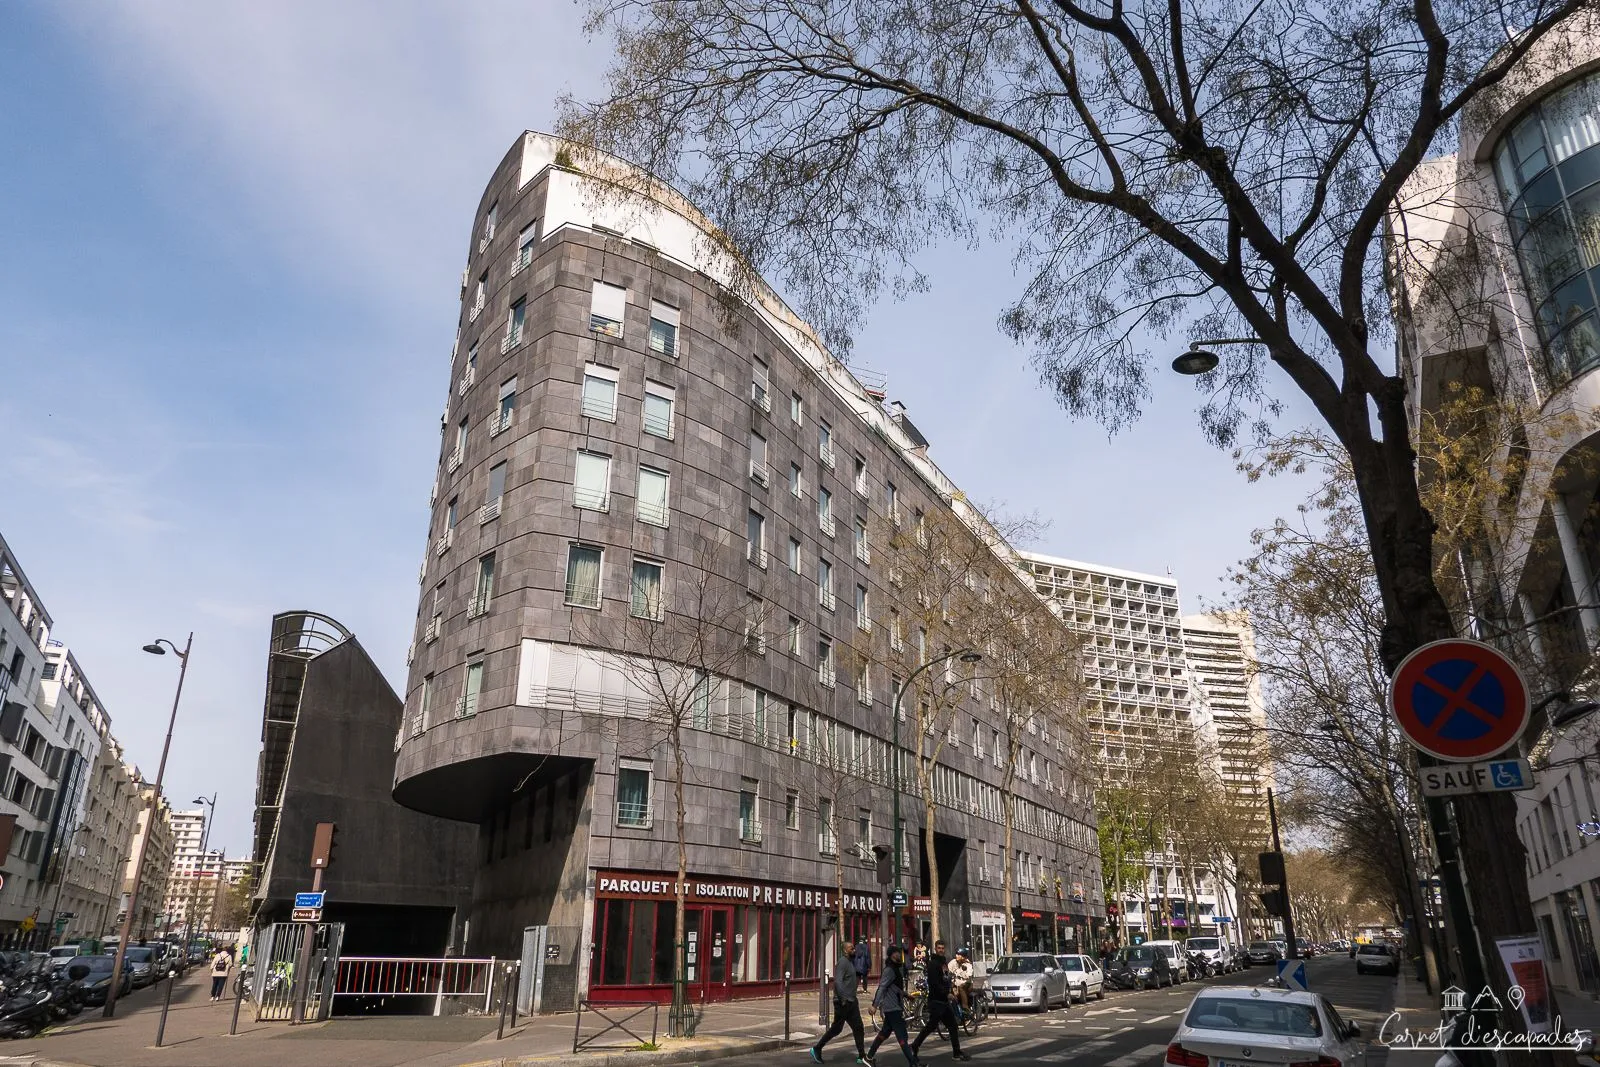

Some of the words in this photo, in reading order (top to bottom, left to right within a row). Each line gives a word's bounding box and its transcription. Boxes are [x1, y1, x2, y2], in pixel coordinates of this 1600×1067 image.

[1426, 769, 1486, 790] SAUF
[600, 878, 669, 894] PARQUET
[696, 883, 749, 898] ISOLATION
[752, 885, 831, 908] PREMIBEL
